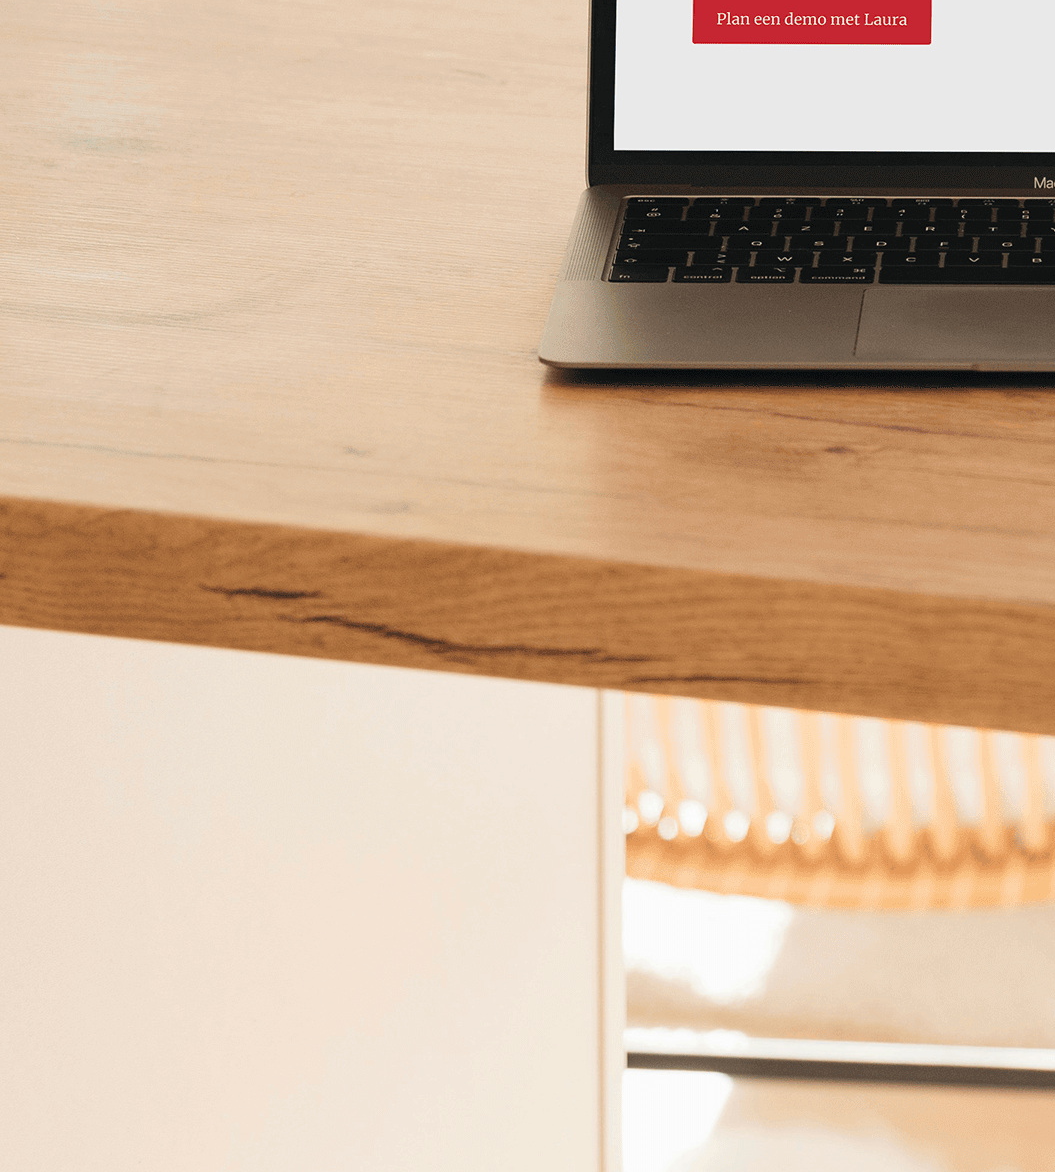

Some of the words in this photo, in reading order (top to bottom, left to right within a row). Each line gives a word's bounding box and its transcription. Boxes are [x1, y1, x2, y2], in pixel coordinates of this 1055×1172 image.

[717, 12, 750, 25] Plan
[754, 16, 780, 25] een
[785, 12, 826, 25] demo
[831, 14, 860, 25] met
[864, 13, 907, 26] Laura
